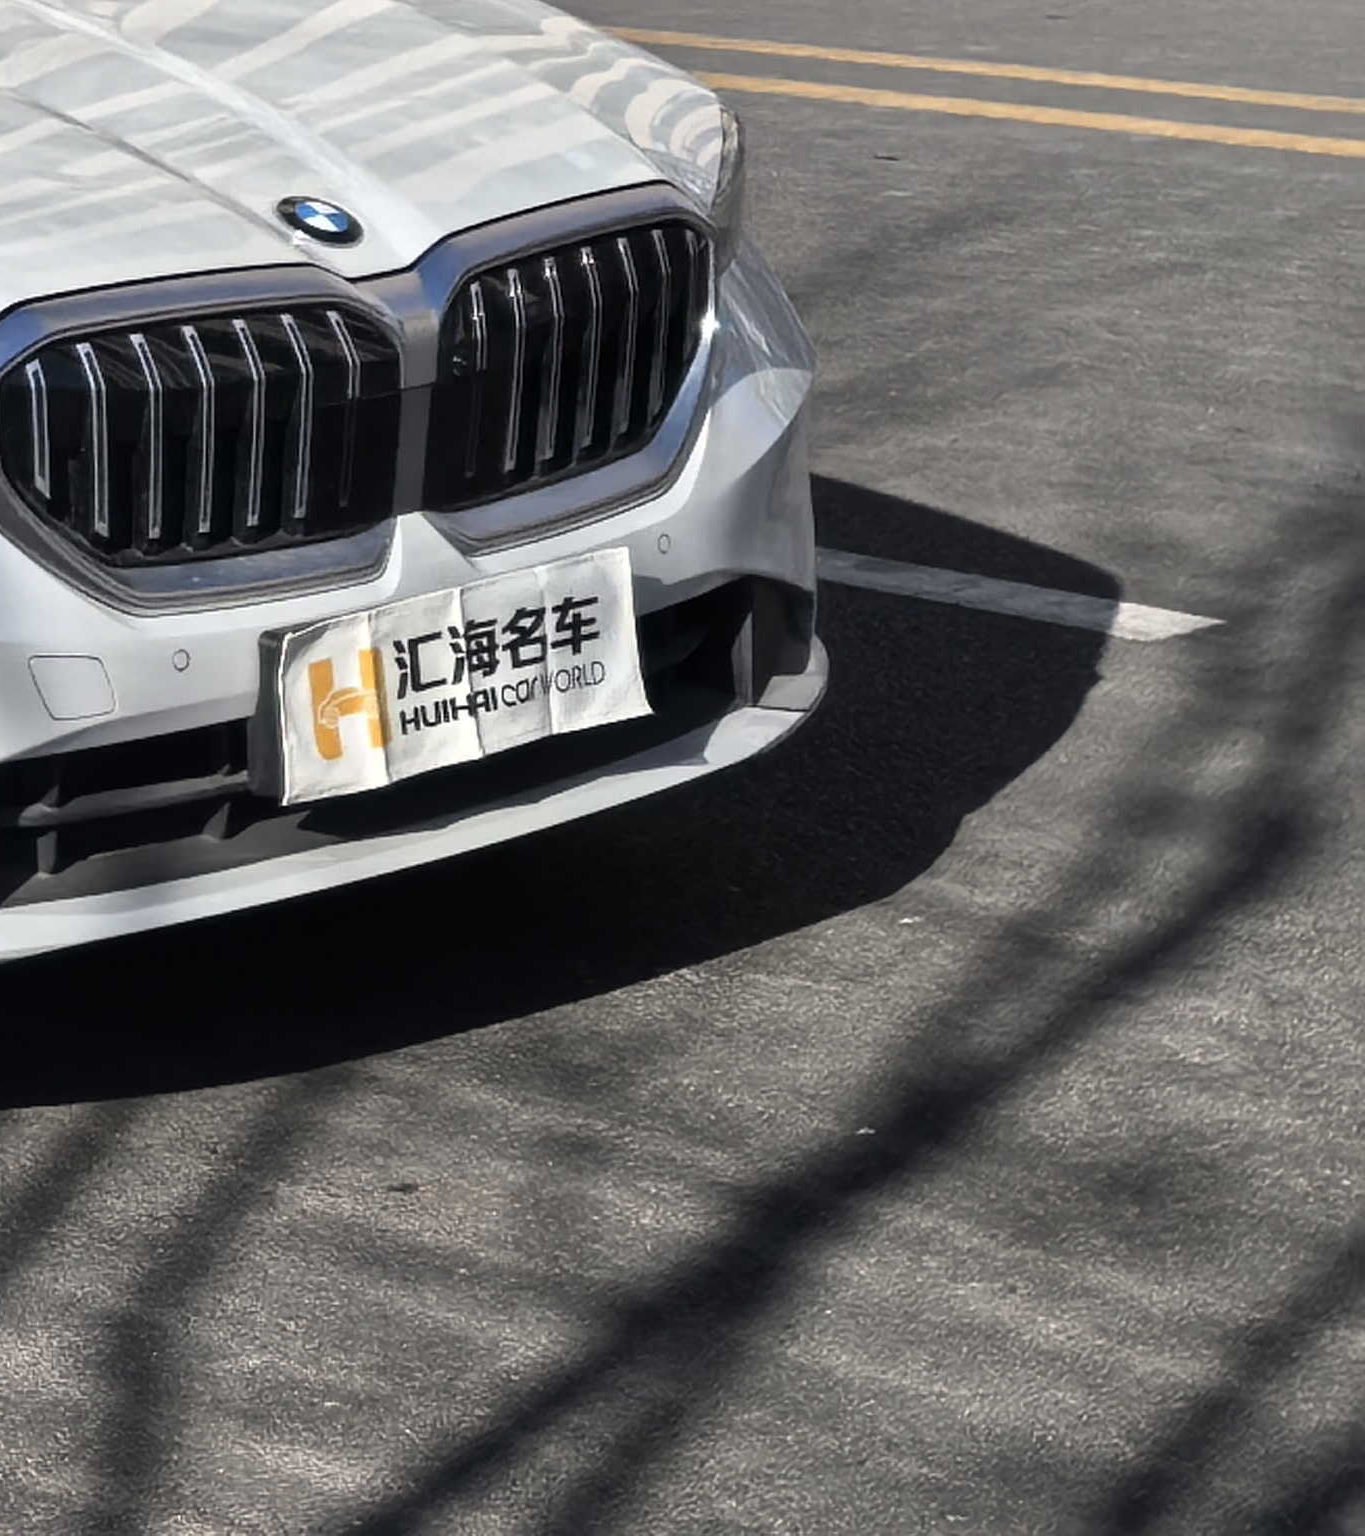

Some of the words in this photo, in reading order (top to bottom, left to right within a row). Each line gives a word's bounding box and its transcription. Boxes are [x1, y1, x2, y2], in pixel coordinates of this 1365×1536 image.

[393, 596, 601, 700] 汇海名车
[399, 686, 499, 735] HUIHAI
